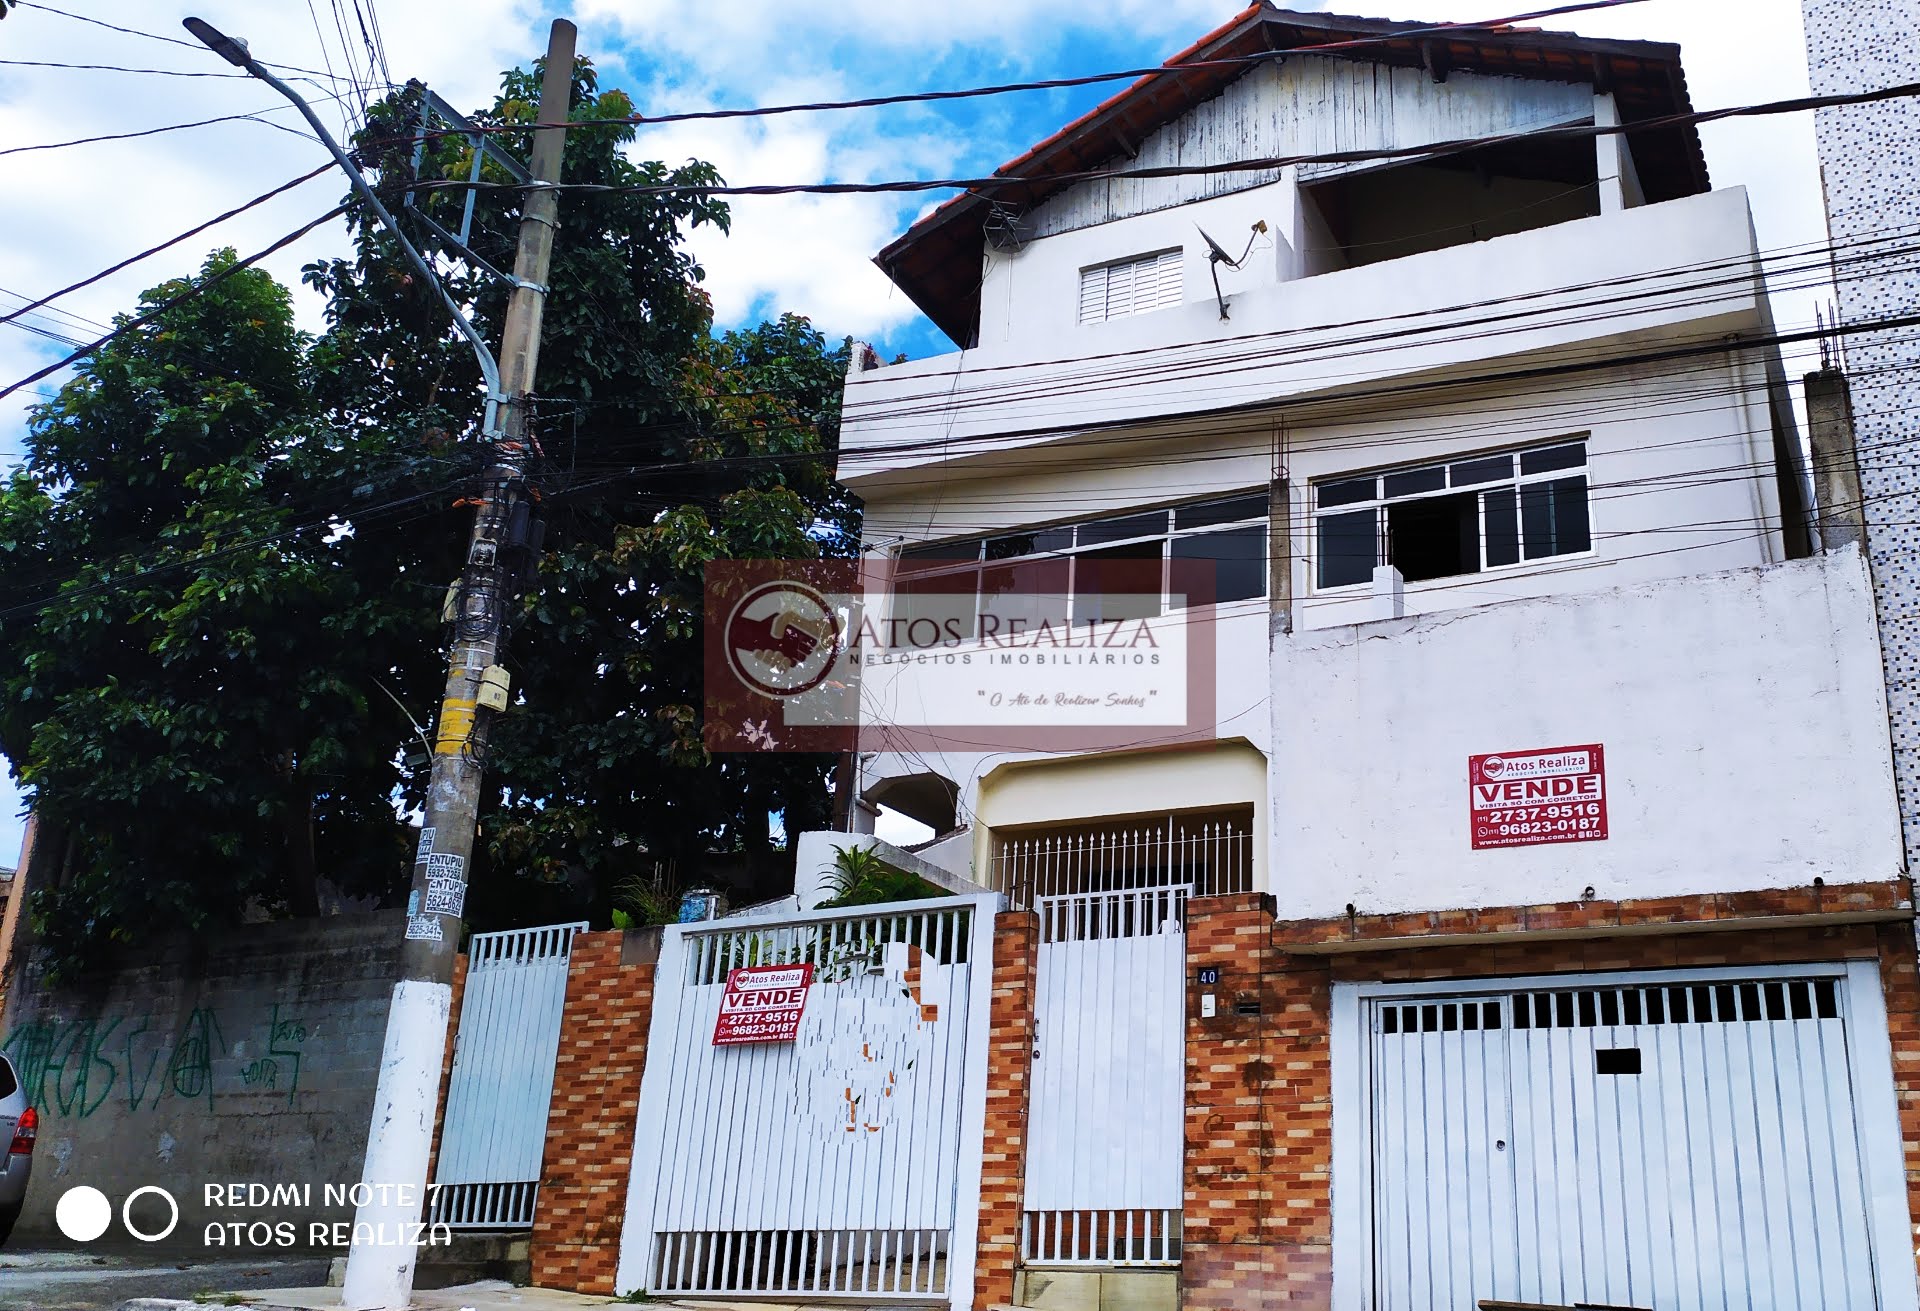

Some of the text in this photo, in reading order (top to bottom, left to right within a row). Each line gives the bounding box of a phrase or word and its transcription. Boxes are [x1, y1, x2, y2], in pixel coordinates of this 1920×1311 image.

[1506, 761, 1535, 773] Atos
[1539, 755, 1585, 769] Realiza
[1478, 776, 1597, 802] VENDE
[1547, 794, 1597, 803] CORRETOR
[1489, 803, 1600, 823] 2737-9516
[1500, 817, 1600, 836] 96823-0187
[1479, 833, 1576, 846] www.atosrealiza.com.br
[429, 855, 463, 868] ENTUPIU
[749, 975, 768, 984] Atos
[770, 972, 800, 983] Realiza
[1200, 971, 1216, 984] 40
[728, 989, 804, 1008] VENDE
[728, 1010, 798, 1025] 2737-9516
[732, 1022, 796, 1036] 96823-0187
